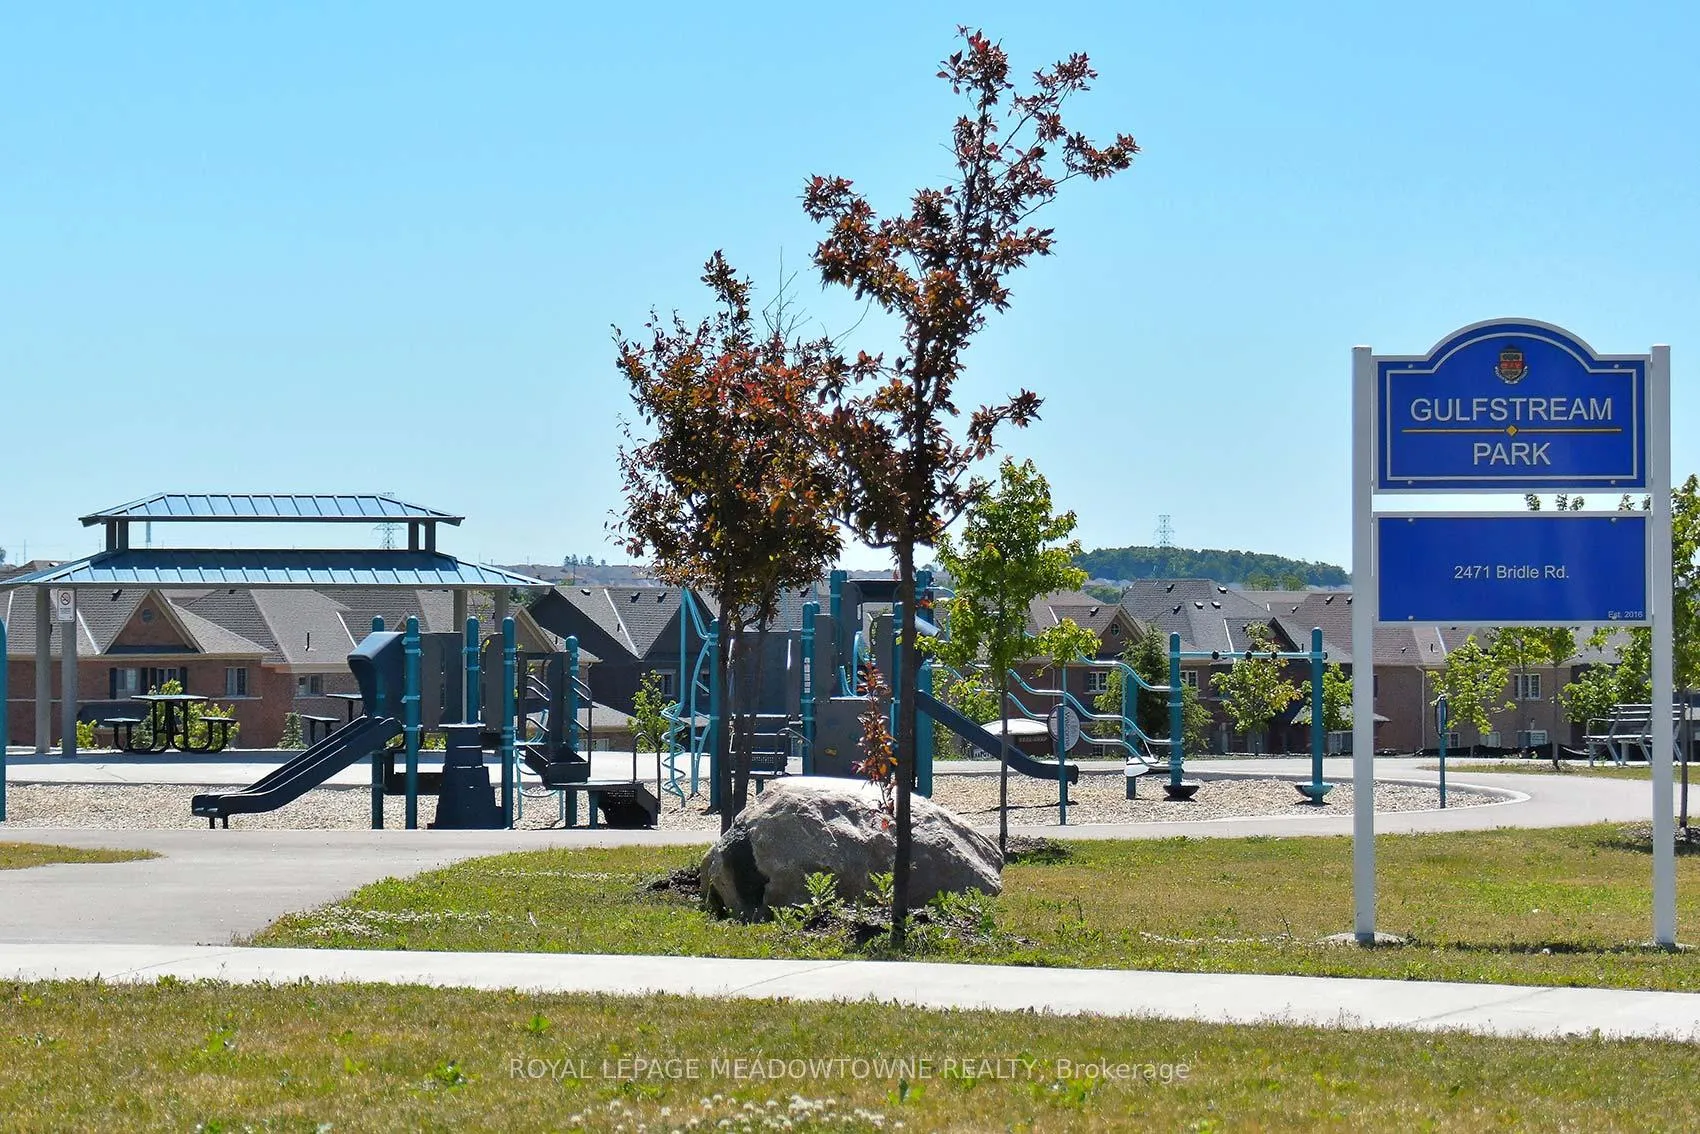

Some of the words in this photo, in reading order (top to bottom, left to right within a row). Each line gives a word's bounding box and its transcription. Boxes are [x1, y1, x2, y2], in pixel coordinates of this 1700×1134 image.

[1410, 397, 1613, 422] GULFSTREAM
[1473, 442, 1551, 466] PARK
[1454, 565, 1490, 580] 2471
[1496, 565, 1539, 580] Bridle
[1544, 565, 1570, 580] Rd.
[1624, 610, 1643, 618] 2016
